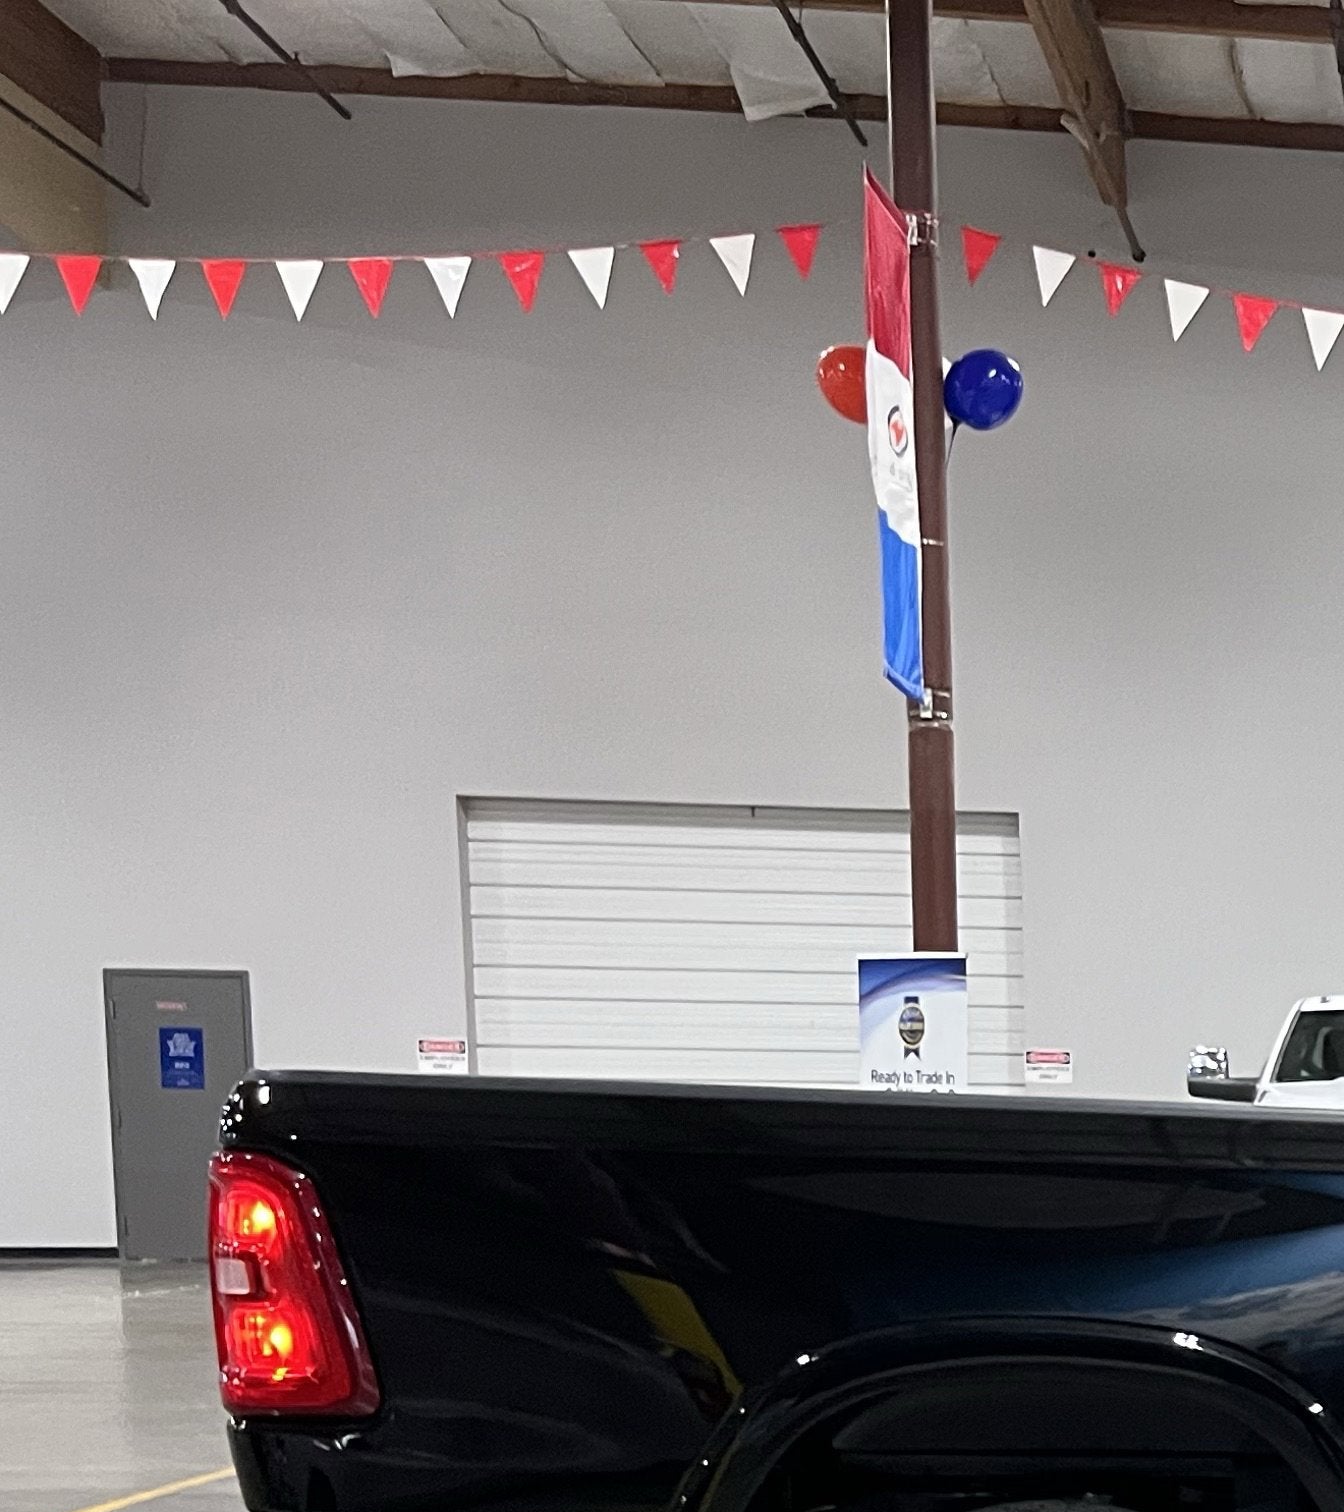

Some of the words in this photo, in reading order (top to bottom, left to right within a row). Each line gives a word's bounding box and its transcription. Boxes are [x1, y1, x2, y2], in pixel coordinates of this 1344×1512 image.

[871, 1069, 900, 1087] Ready
[904, 1071, 913, 1084] to
[916, 1070, 943, 1085] Trade
[946, 1070, 955, 1085] In
